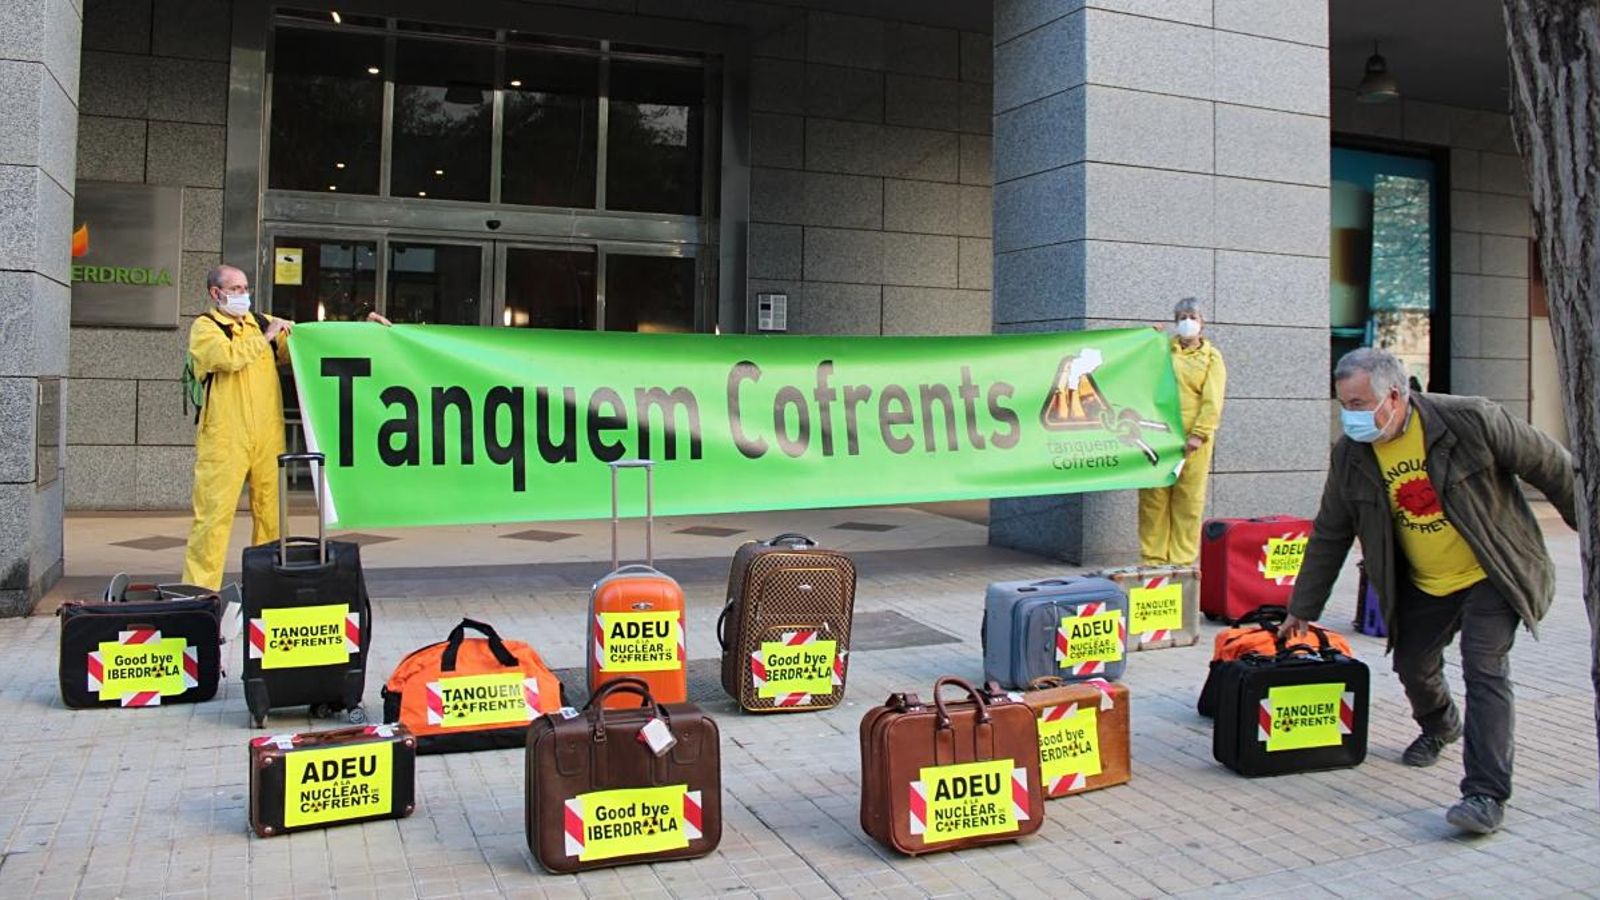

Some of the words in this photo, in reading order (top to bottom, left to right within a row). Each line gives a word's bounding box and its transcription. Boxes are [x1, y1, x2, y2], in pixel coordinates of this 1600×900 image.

[320, 357, 702, 492] Tanquem
[727, 360, 1020, 459] Cofrents
[1046, 439, 1118, 456] tanquem
[1052, 453, 1119, 470] Cofrents
[1273, 543, 1306, 555] ADEU
[1136, 599, 1176, 610] TANQUEM
[271, 624, 339, 638] TANQUEM
[610, 620, 669, 639] ADEU
[1071, 619, 1113, 640] ADEU
[610, 643, 664, 653] NUCLEAR
[114, 653, 147, 666] Good
[151, 653, 173, 667] bye
[768, 652, 800, 667] Good
[804, 651, 827, 667] bye
[442, 684, 520, 702] TANQUEM
[1276, 703, 1334, 717] TANQUEM
[1065, 729, 1084, 742] bye
[301, 755, 377, 784] ADEU
[300, 783, 369, 802] NUCLEAR
[935, 773, 1001, 801] ADEU
[595, 803, 636, 821] Good
[641, 802, 670, 819] bye
[935, 802, 996, 821] NUCLEAR
